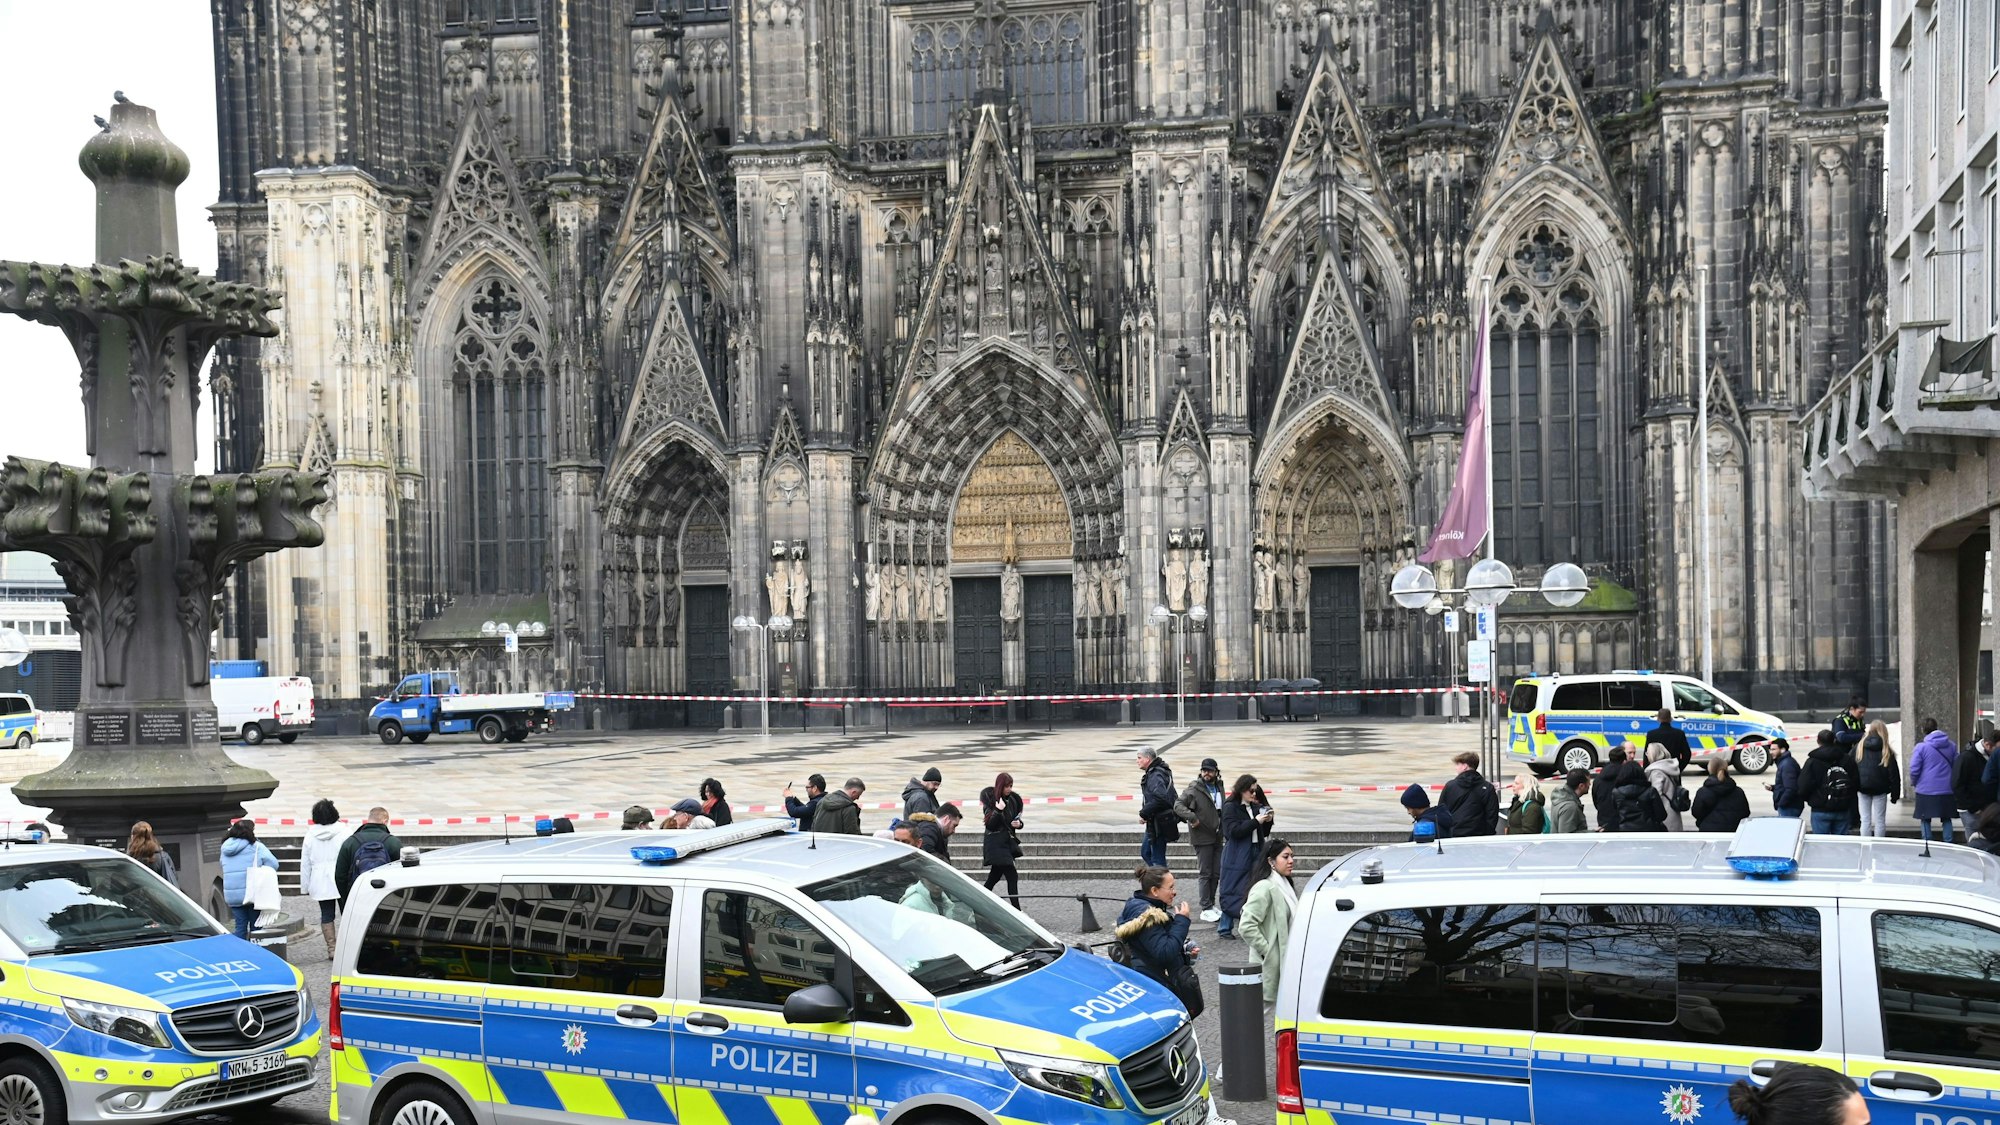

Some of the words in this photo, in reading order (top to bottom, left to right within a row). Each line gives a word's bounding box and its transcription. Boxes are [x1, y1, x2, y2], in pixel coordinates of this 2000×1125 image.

[18, 661, 32, 676] U
[1681, 722, 1716, 732] POLIZEI
[155, 960, 261, 983] POLIZEI
[1069, 981, 1148, 1022] POLIZEI
[229, 1061, 247, 1077] NRW
[252, 1053, 285, 1073] 5-3169
[711, 1043, 818, 1079] POLIZEI
